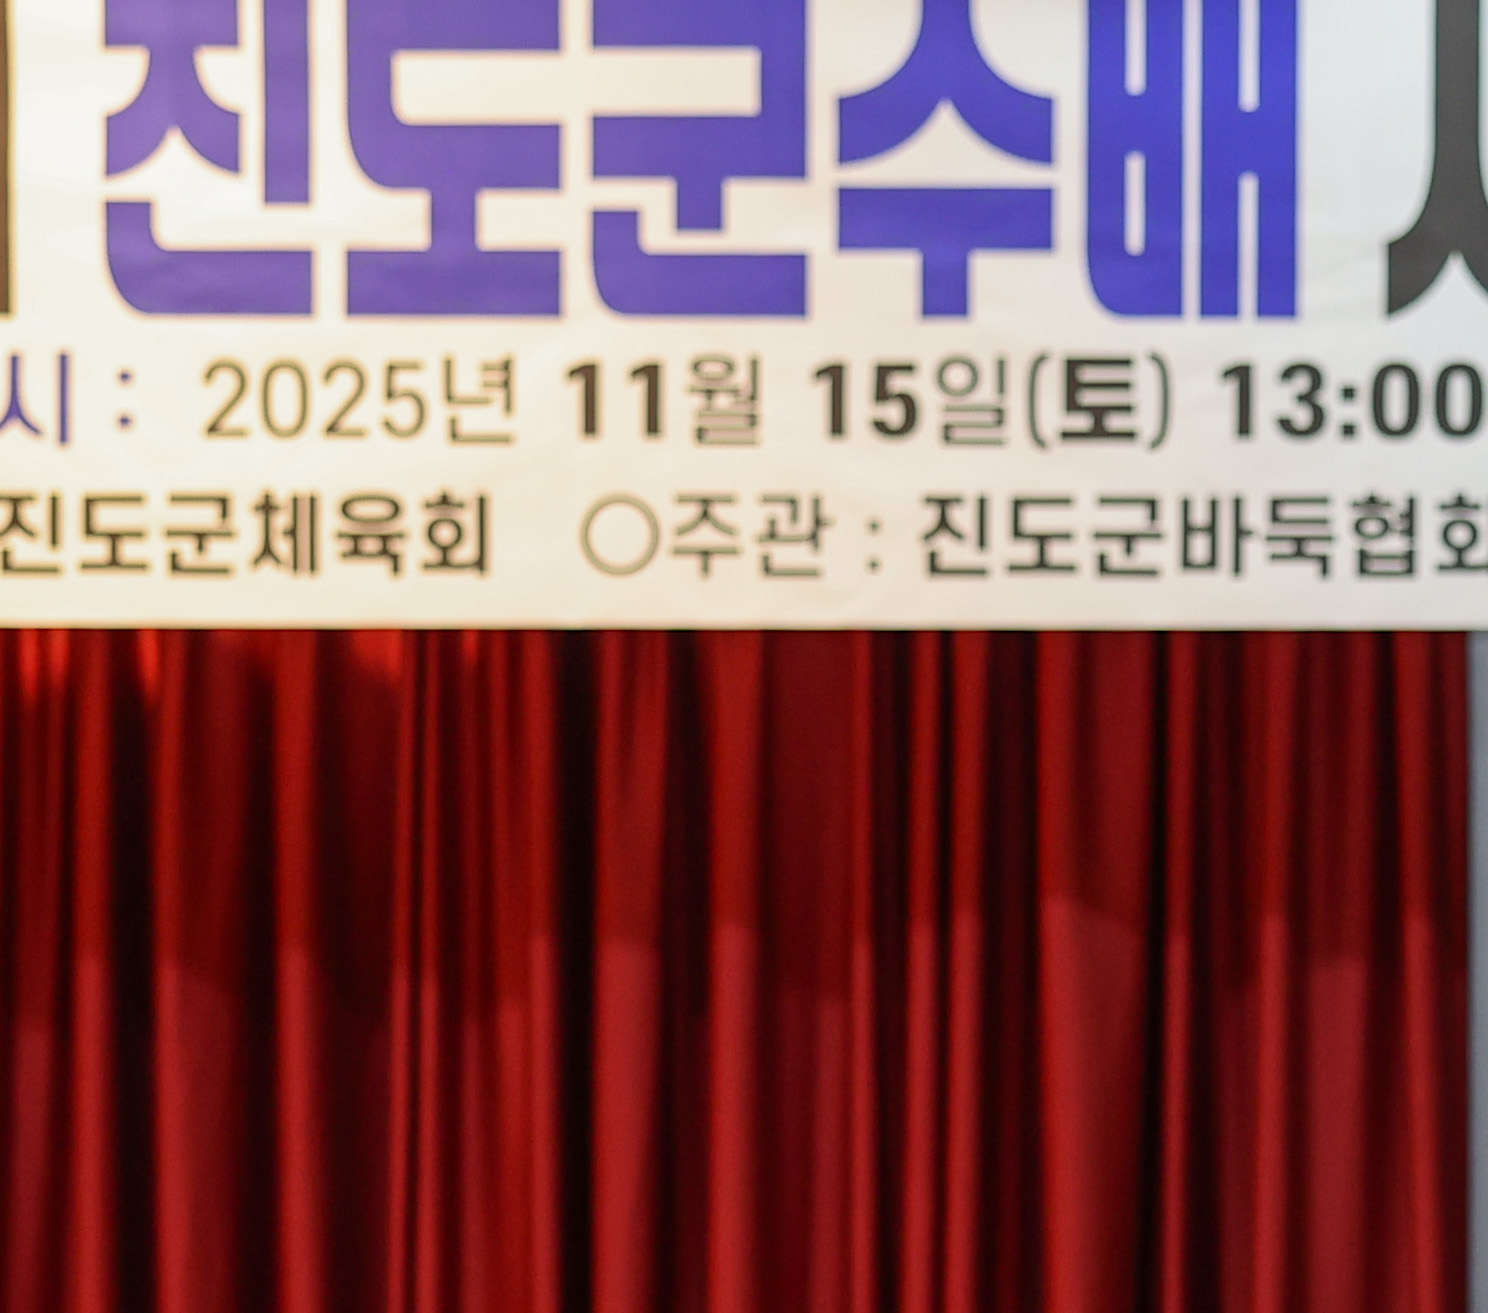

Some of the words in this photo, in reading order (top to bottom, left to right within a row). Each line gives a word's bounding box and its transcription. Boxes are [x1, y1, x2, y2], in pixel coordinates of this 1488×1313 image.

[103, 0, 1299, 318] 진도군수배
[203, 356, 515, 446] 2025년
[565, 355, 761, 447] 11월
[810, 350, 1172, 452] 15일(토)
